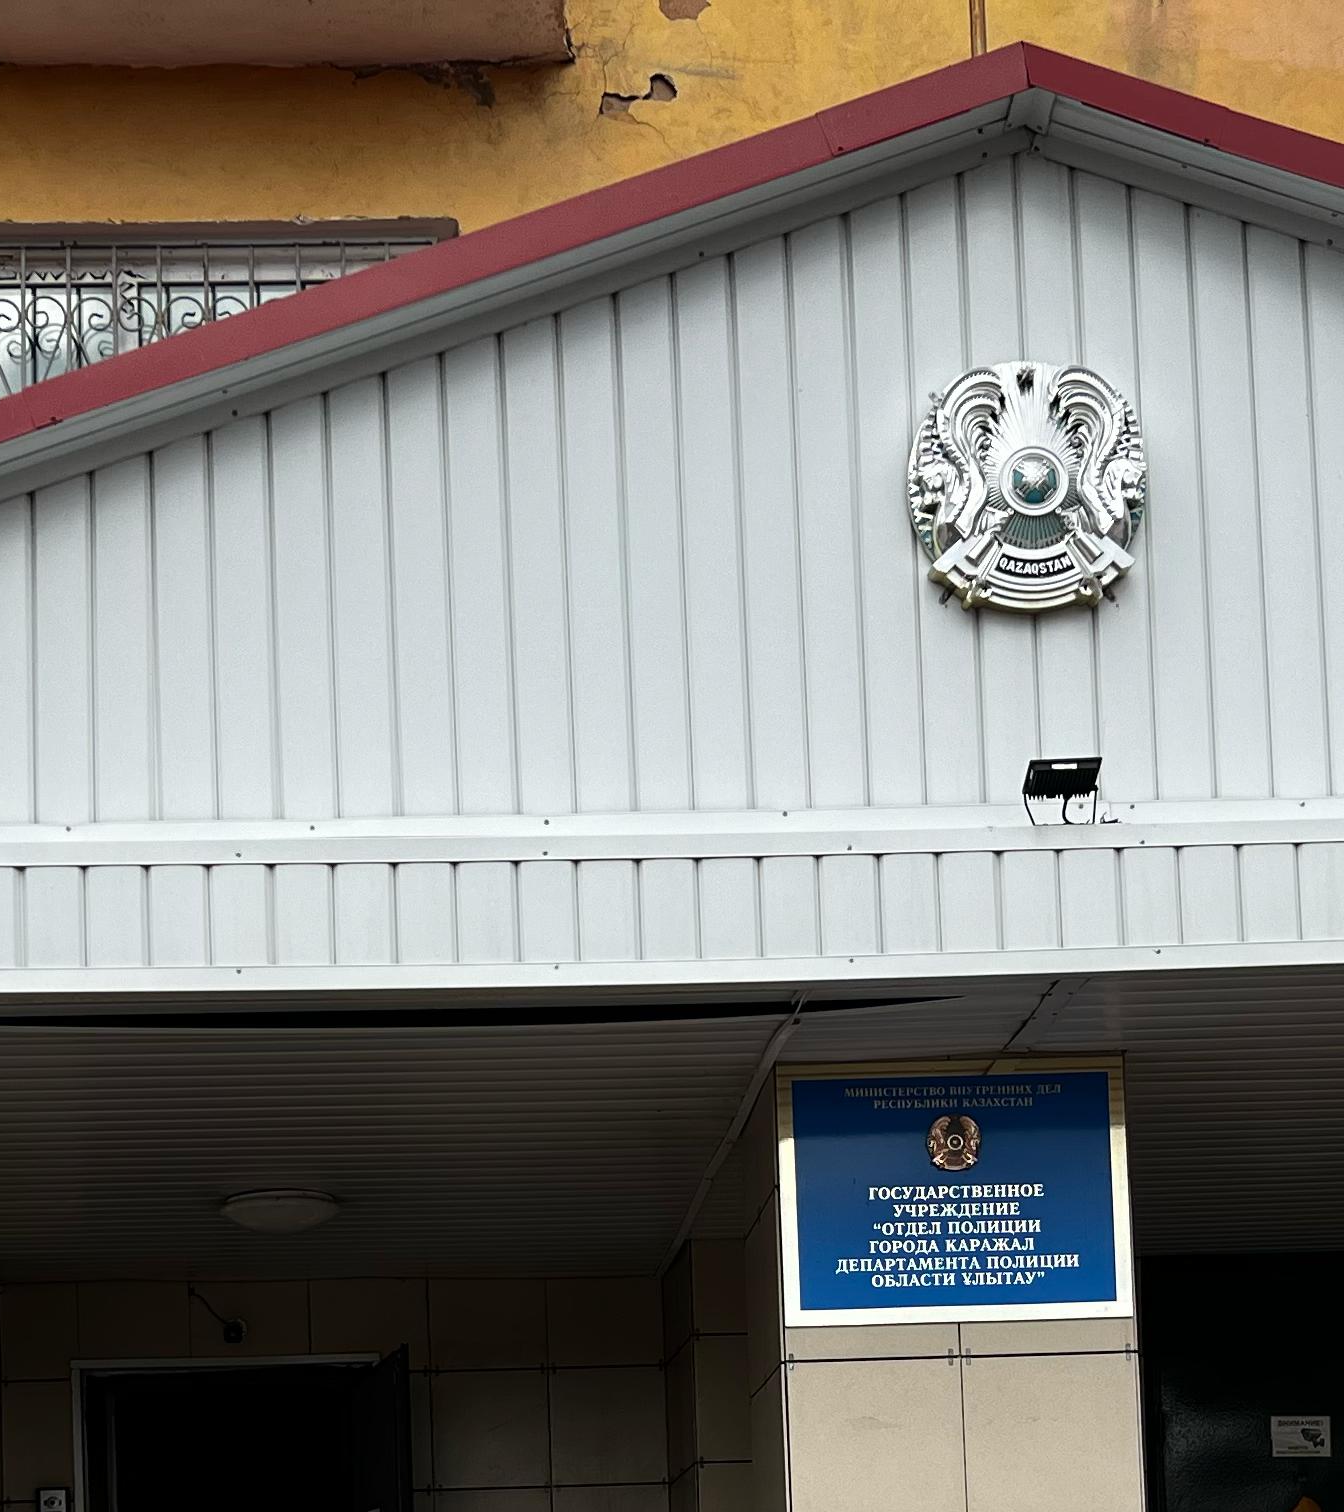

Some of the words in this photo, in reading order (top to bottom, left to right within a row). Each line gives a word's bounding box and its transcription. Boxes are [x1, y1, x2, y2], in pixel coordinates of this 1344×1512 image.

[999, 557, 1072, 575] QAZAQSTAN
[845, 1087, 945, 1098] МИНИСТЕРСТВО
[1037, 1084, 1061, 1095] ДЕЛ
[874, 1098, 958, 1109] РЕСПУБЛИКИ
[963, 1097, 1033, 1108] КАЗАХСТАН
[868, 1183, 1044, 1202] ГОСУДАРСТВЕННОЕ
[894, 1202, 1020, 1218] УЧРЕЖДЕНИЕ
[947, 1219, 1041, 1234] ПОЛИЦИИ
[869, 1239, 938, 1255] ГОРОДА
[945, 1238, 1034, 1252] КАРАЖАЛ
[835, 1257, 980, 1274] ДЕПАРТАМЕНТА
[987, 1254, 1079, 1270] ПОЛИЦИИ
[872, 1274, 955, 1288] ОБЛАСТИ
